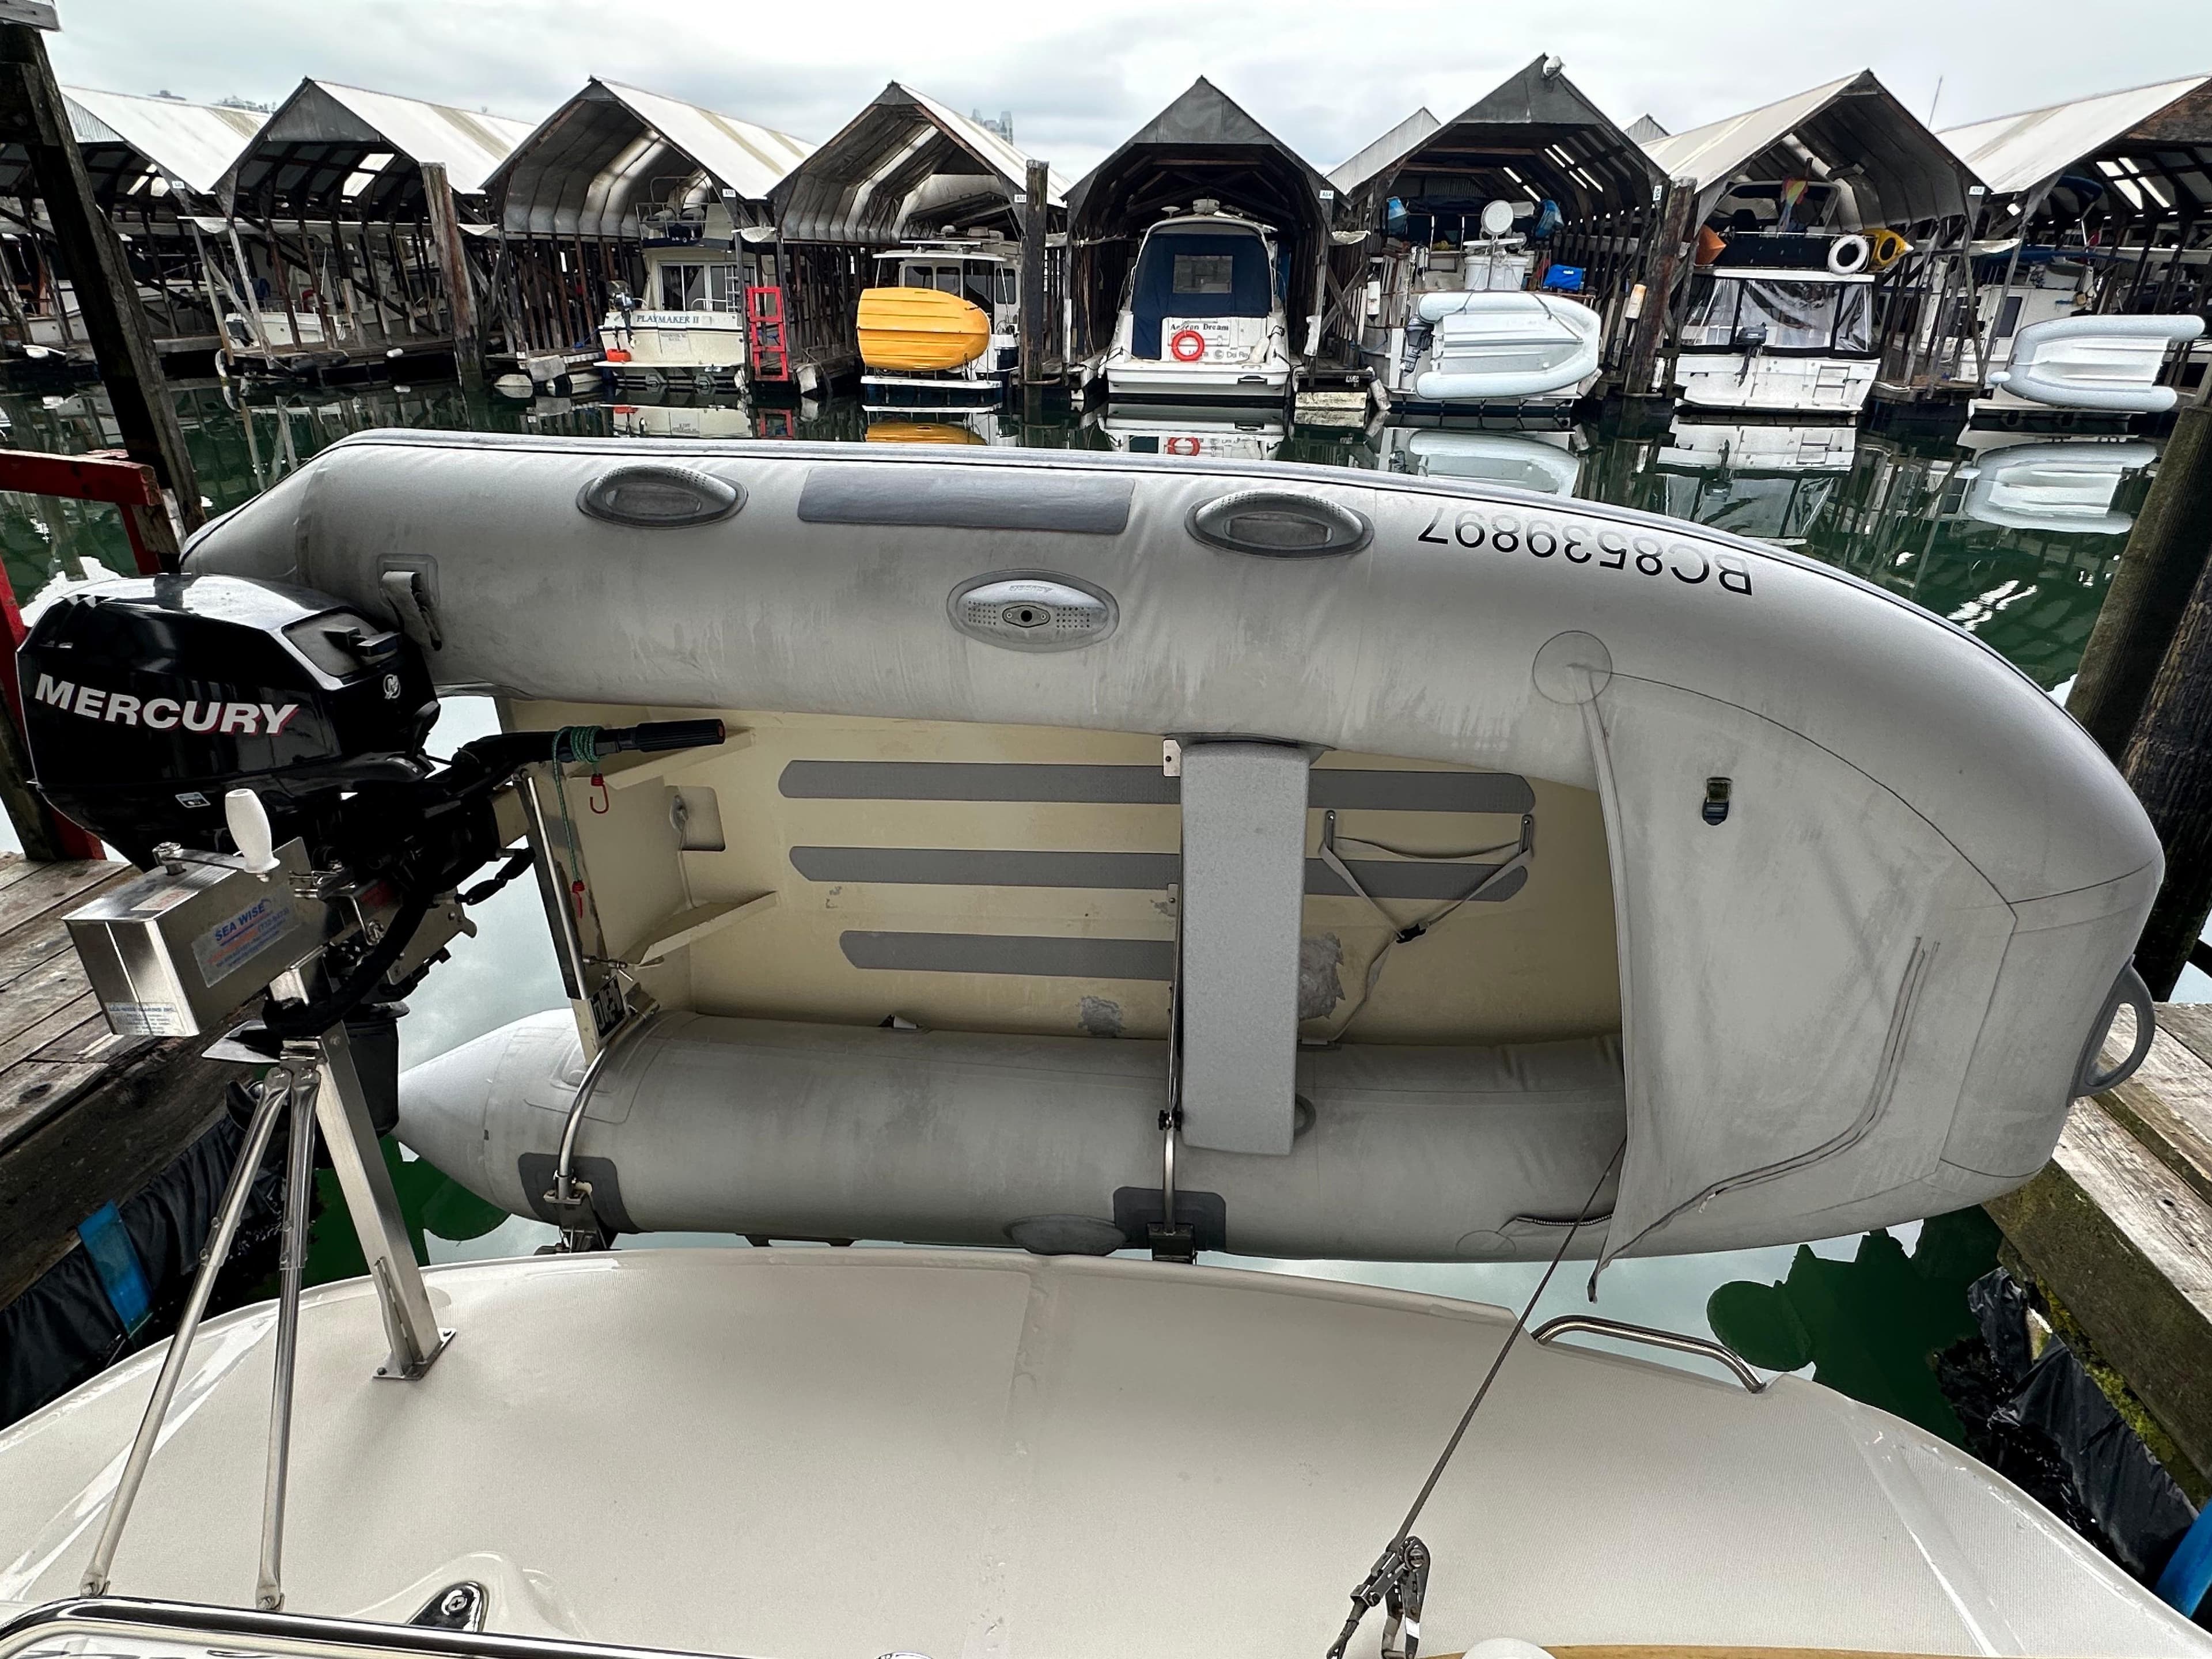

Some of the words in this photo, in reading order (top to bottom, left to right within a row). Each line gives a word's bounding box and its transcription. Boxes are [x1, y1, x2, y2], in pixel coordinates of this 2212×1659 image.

[637, 315, 690, 324] PLAYMAKER
[1203, 323, 1229, 331] Dream
[1417, 507, 1753, 596] BC8539897
[35, 673, 299, 736] MERCURY
[215, 922, 237, 941] SEA
[238, 902, 266, 926] WISE
